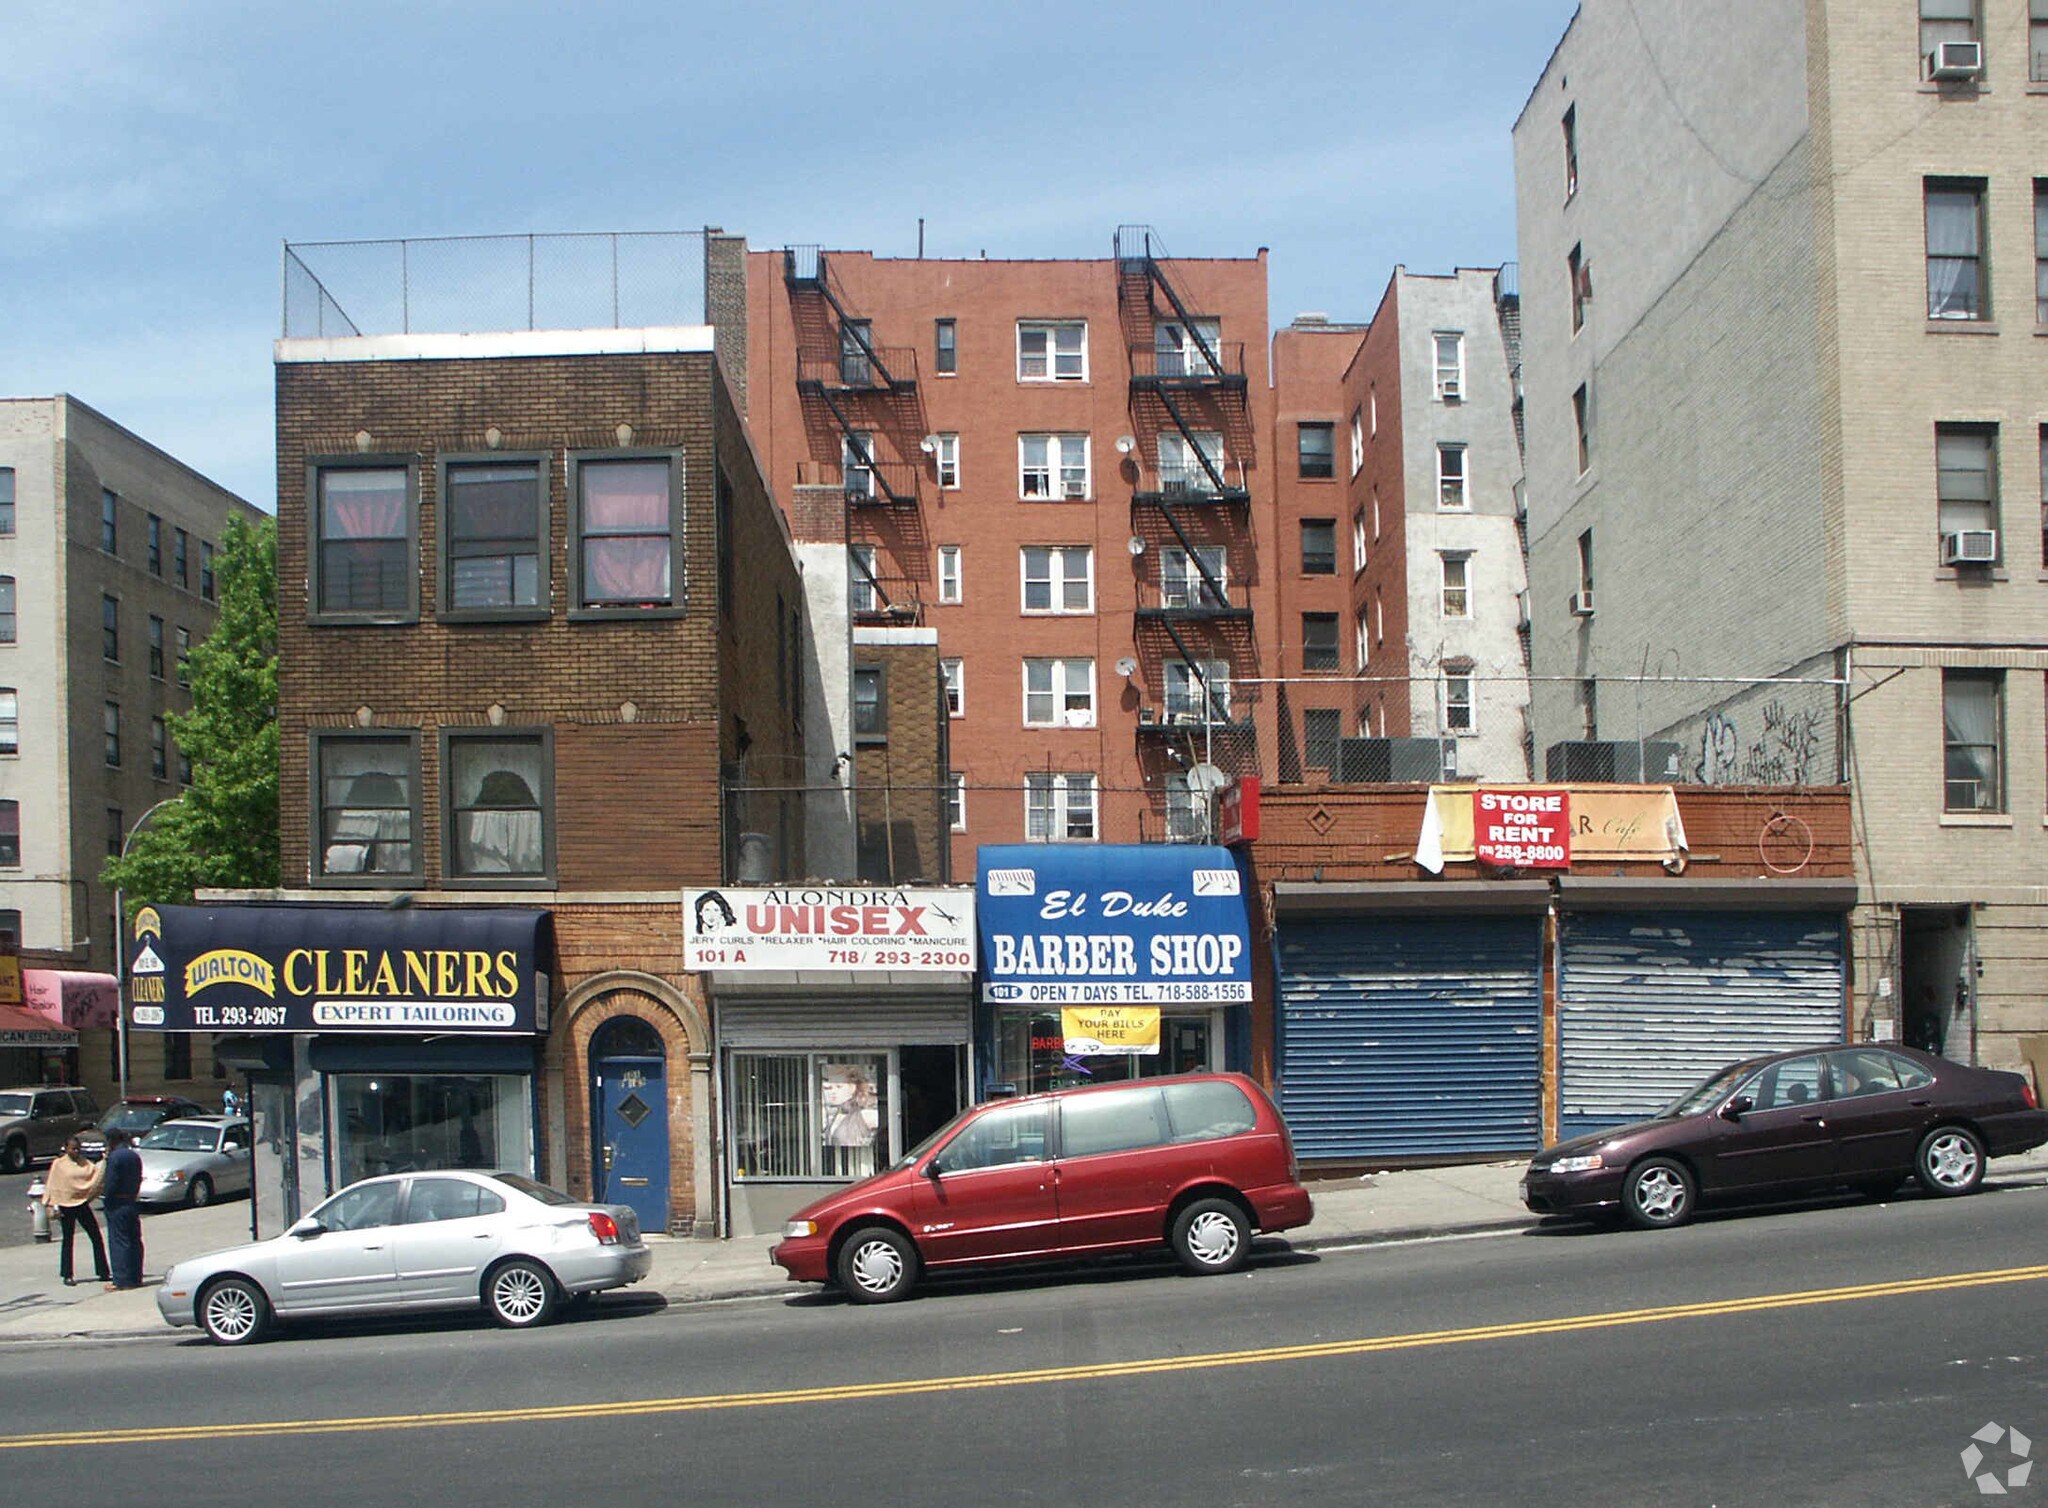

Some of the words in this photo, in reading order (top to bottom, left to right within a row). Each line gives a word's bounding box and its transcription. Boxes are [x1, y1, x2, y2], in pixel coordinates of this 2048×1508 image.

[1481, 794, 1562, 812] STORE
[1503, 812, 1539, 826] FOR
[1489, 827, 1554, 843] RENT
[1495, 845, 1565, 860] 258-8800
[763, 890, 909, 905] ALONDRA
[1039, 890, 1087, 920] El
[1100, 890, 1189, 919] Duke
[746, 904, 929, 935] UNISEX
[689, 936, 716, 945] JERY
[719, 936, 755, 945] CURLS
[851, 936, 906, 946] COLORING
[696, 950, 726, 963] 101
[734, 951, 747, 963] A
[875, 951, 971, 966] 293-2300
[993, 934, 1138, 976] BARBER
[1150, 934, 1242, 976] SHOP
[193, 957, 267, 986] WALTON
[283, 948, 520, 998] CLEANERS
[28, 984, 49, 995] Hair
[133, 976, 166, 1003] CLEANERS
[1029, 986, 1066, 1000] OPEN
[1071, 985, 1080, 999] 7
[1083, 985, 1118, 1000] DAYS
[1123, 985, 1153, 999] TEL.
[1157, 984, 1246, 999] 718-588-1556
[29, 999, 57, 1010] Salon
[193, 1006, 220, 1025] TEL.
[221, 1006, 287, 1025] 293-2087
[320, 1006, 393, 1020] EXPERT
[401, 1006, 505, 1022] TAILORING
[1078, 1020, 1109, 1029] YOUR
[1113, 1020, 1145, 1029] BILLS
[1097, 1030, 1126, 1040] HERE
